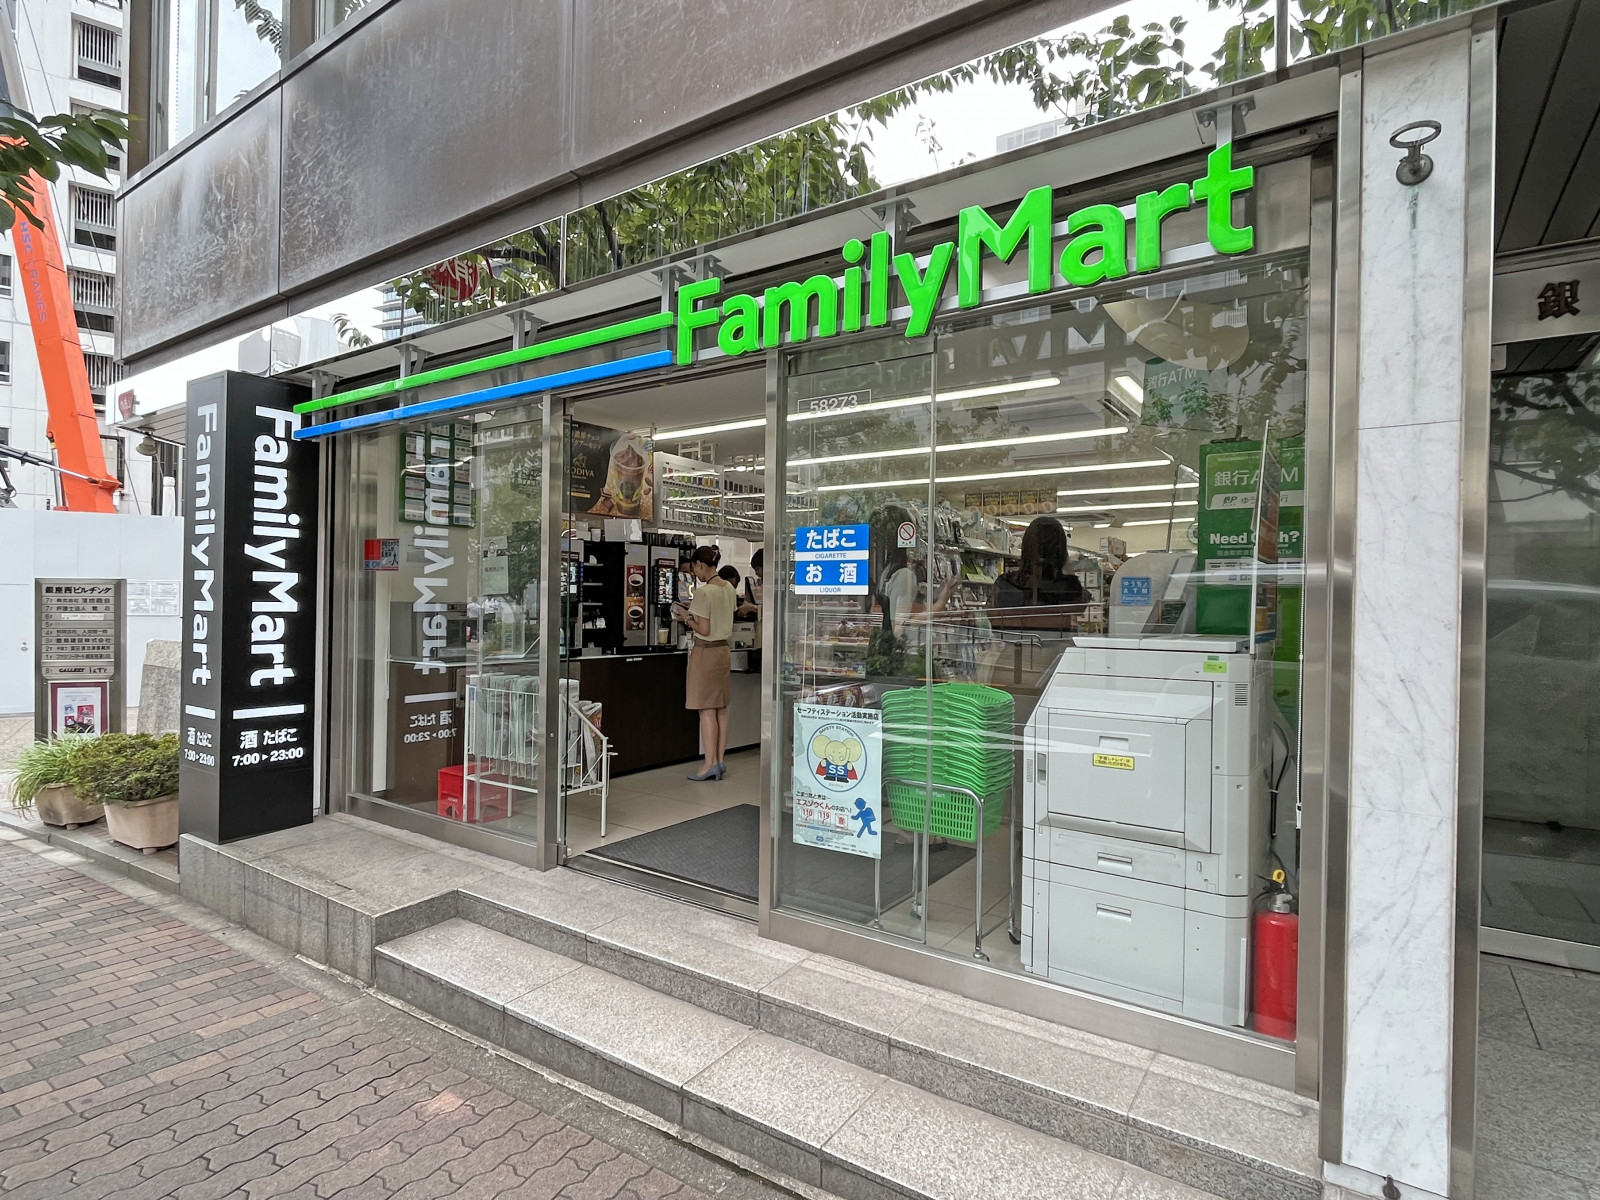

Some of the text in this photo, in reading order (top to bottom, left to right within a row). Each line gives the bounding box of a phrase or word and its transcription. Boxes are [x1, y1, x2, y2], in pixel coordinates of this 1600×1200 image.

[677, 142, 1254, 366] FamilyMart
[1536, 280, 1580, 321] 銀
[810, 394, 858, 414] 58273
[191, 403, 218, 686] FamilyMart
[243, 405, 301, 687] FamilyMart
[806, 528, 857, 549] たばこ
[1210, 533, 1248, 545] Need
[196, 730, 213, 748] たばこ
[240, 727, 298, 749] 酒 たばこ
[829, 764, 845, 775] SS
[802, 808, 830, 819] 110 119
